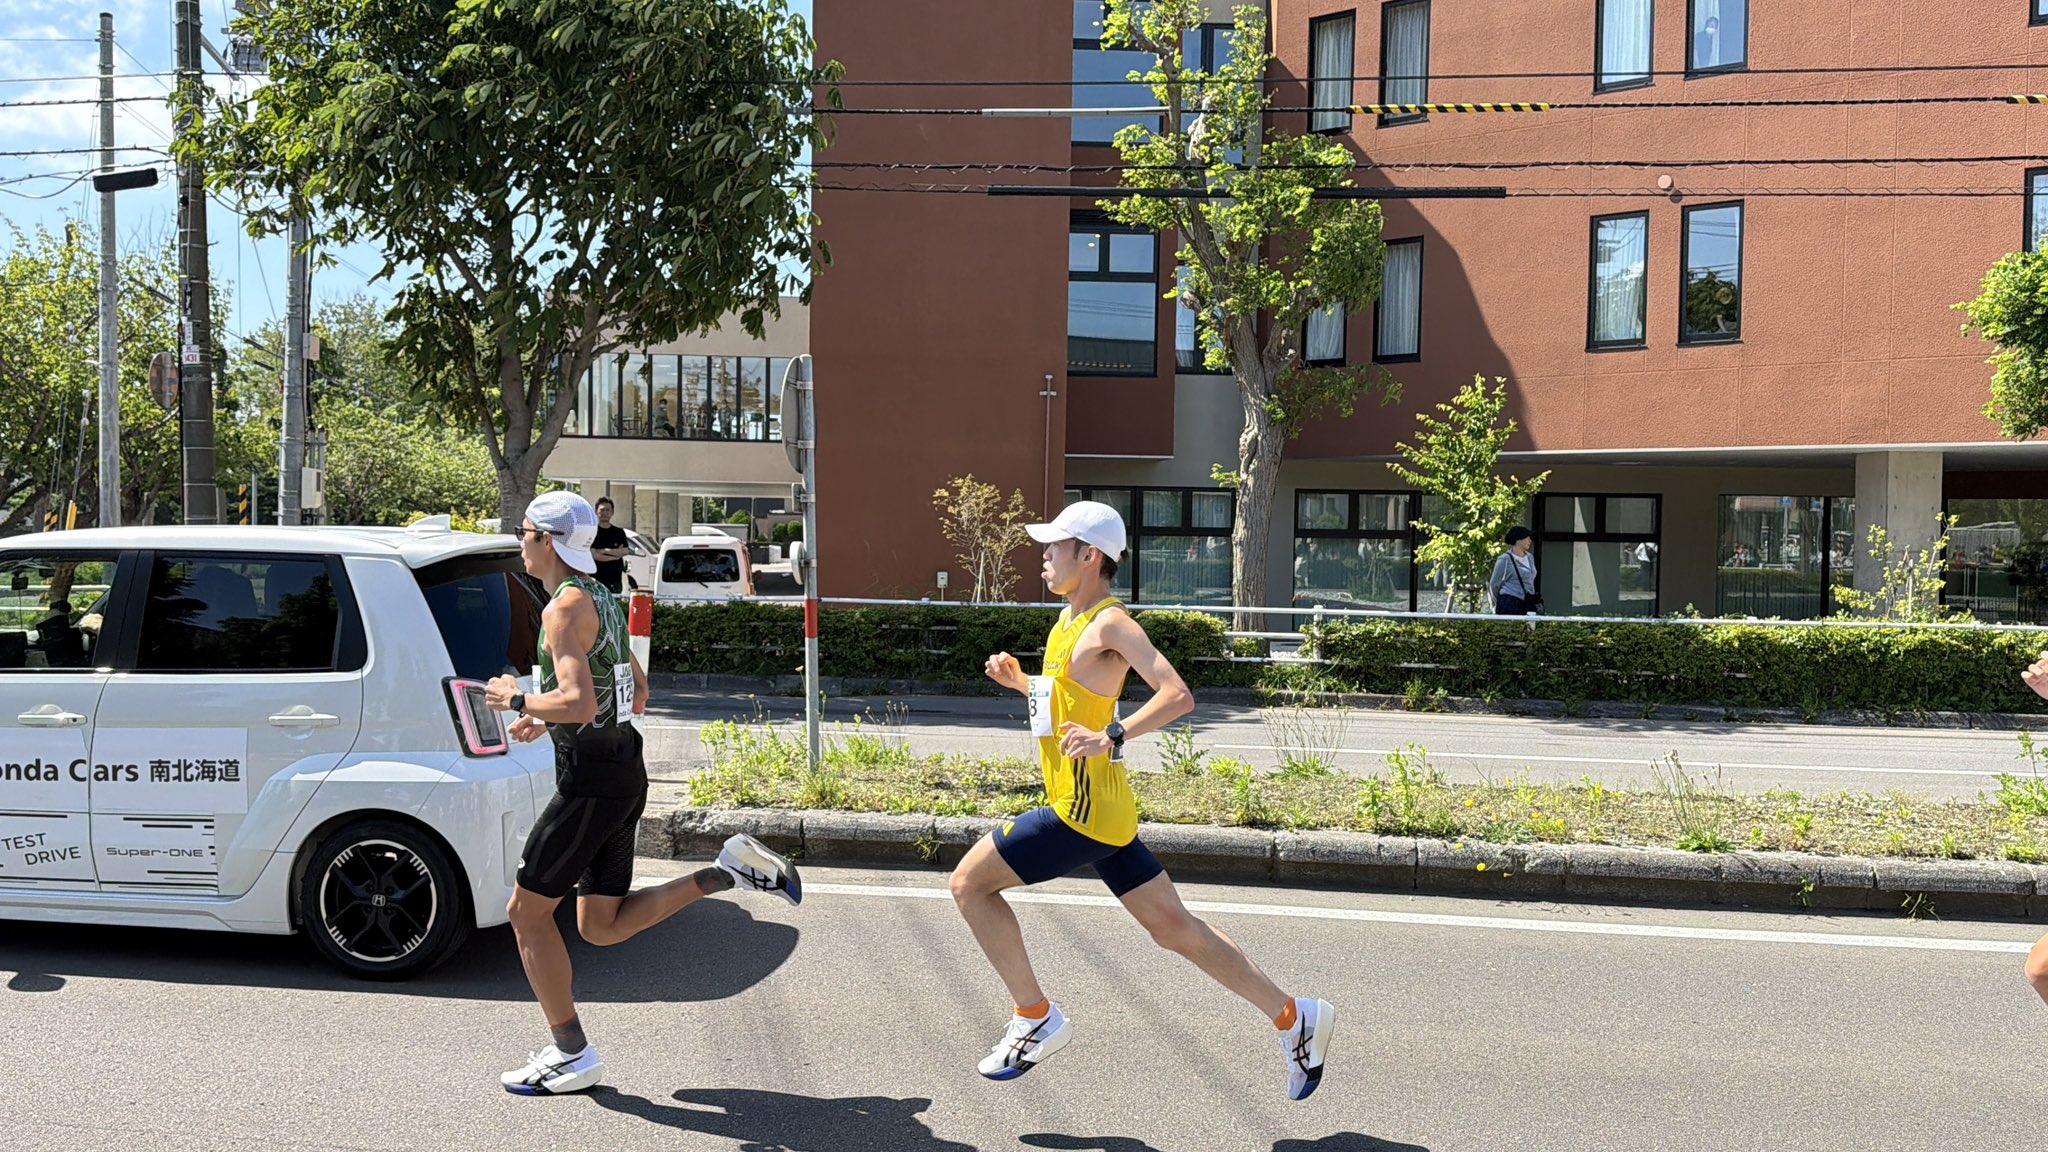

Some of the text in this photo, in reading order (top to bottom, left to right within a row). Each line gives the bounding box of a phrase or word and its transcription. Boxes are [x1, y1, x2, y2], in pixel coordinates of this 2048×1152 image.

[0, 758, 241, 783] nda Cars 南北海道
[2, 833, 47, 851] TEST
[24, 846, 82, 866] DRIVE
[106, 847, 204, 858] Super-ONE
